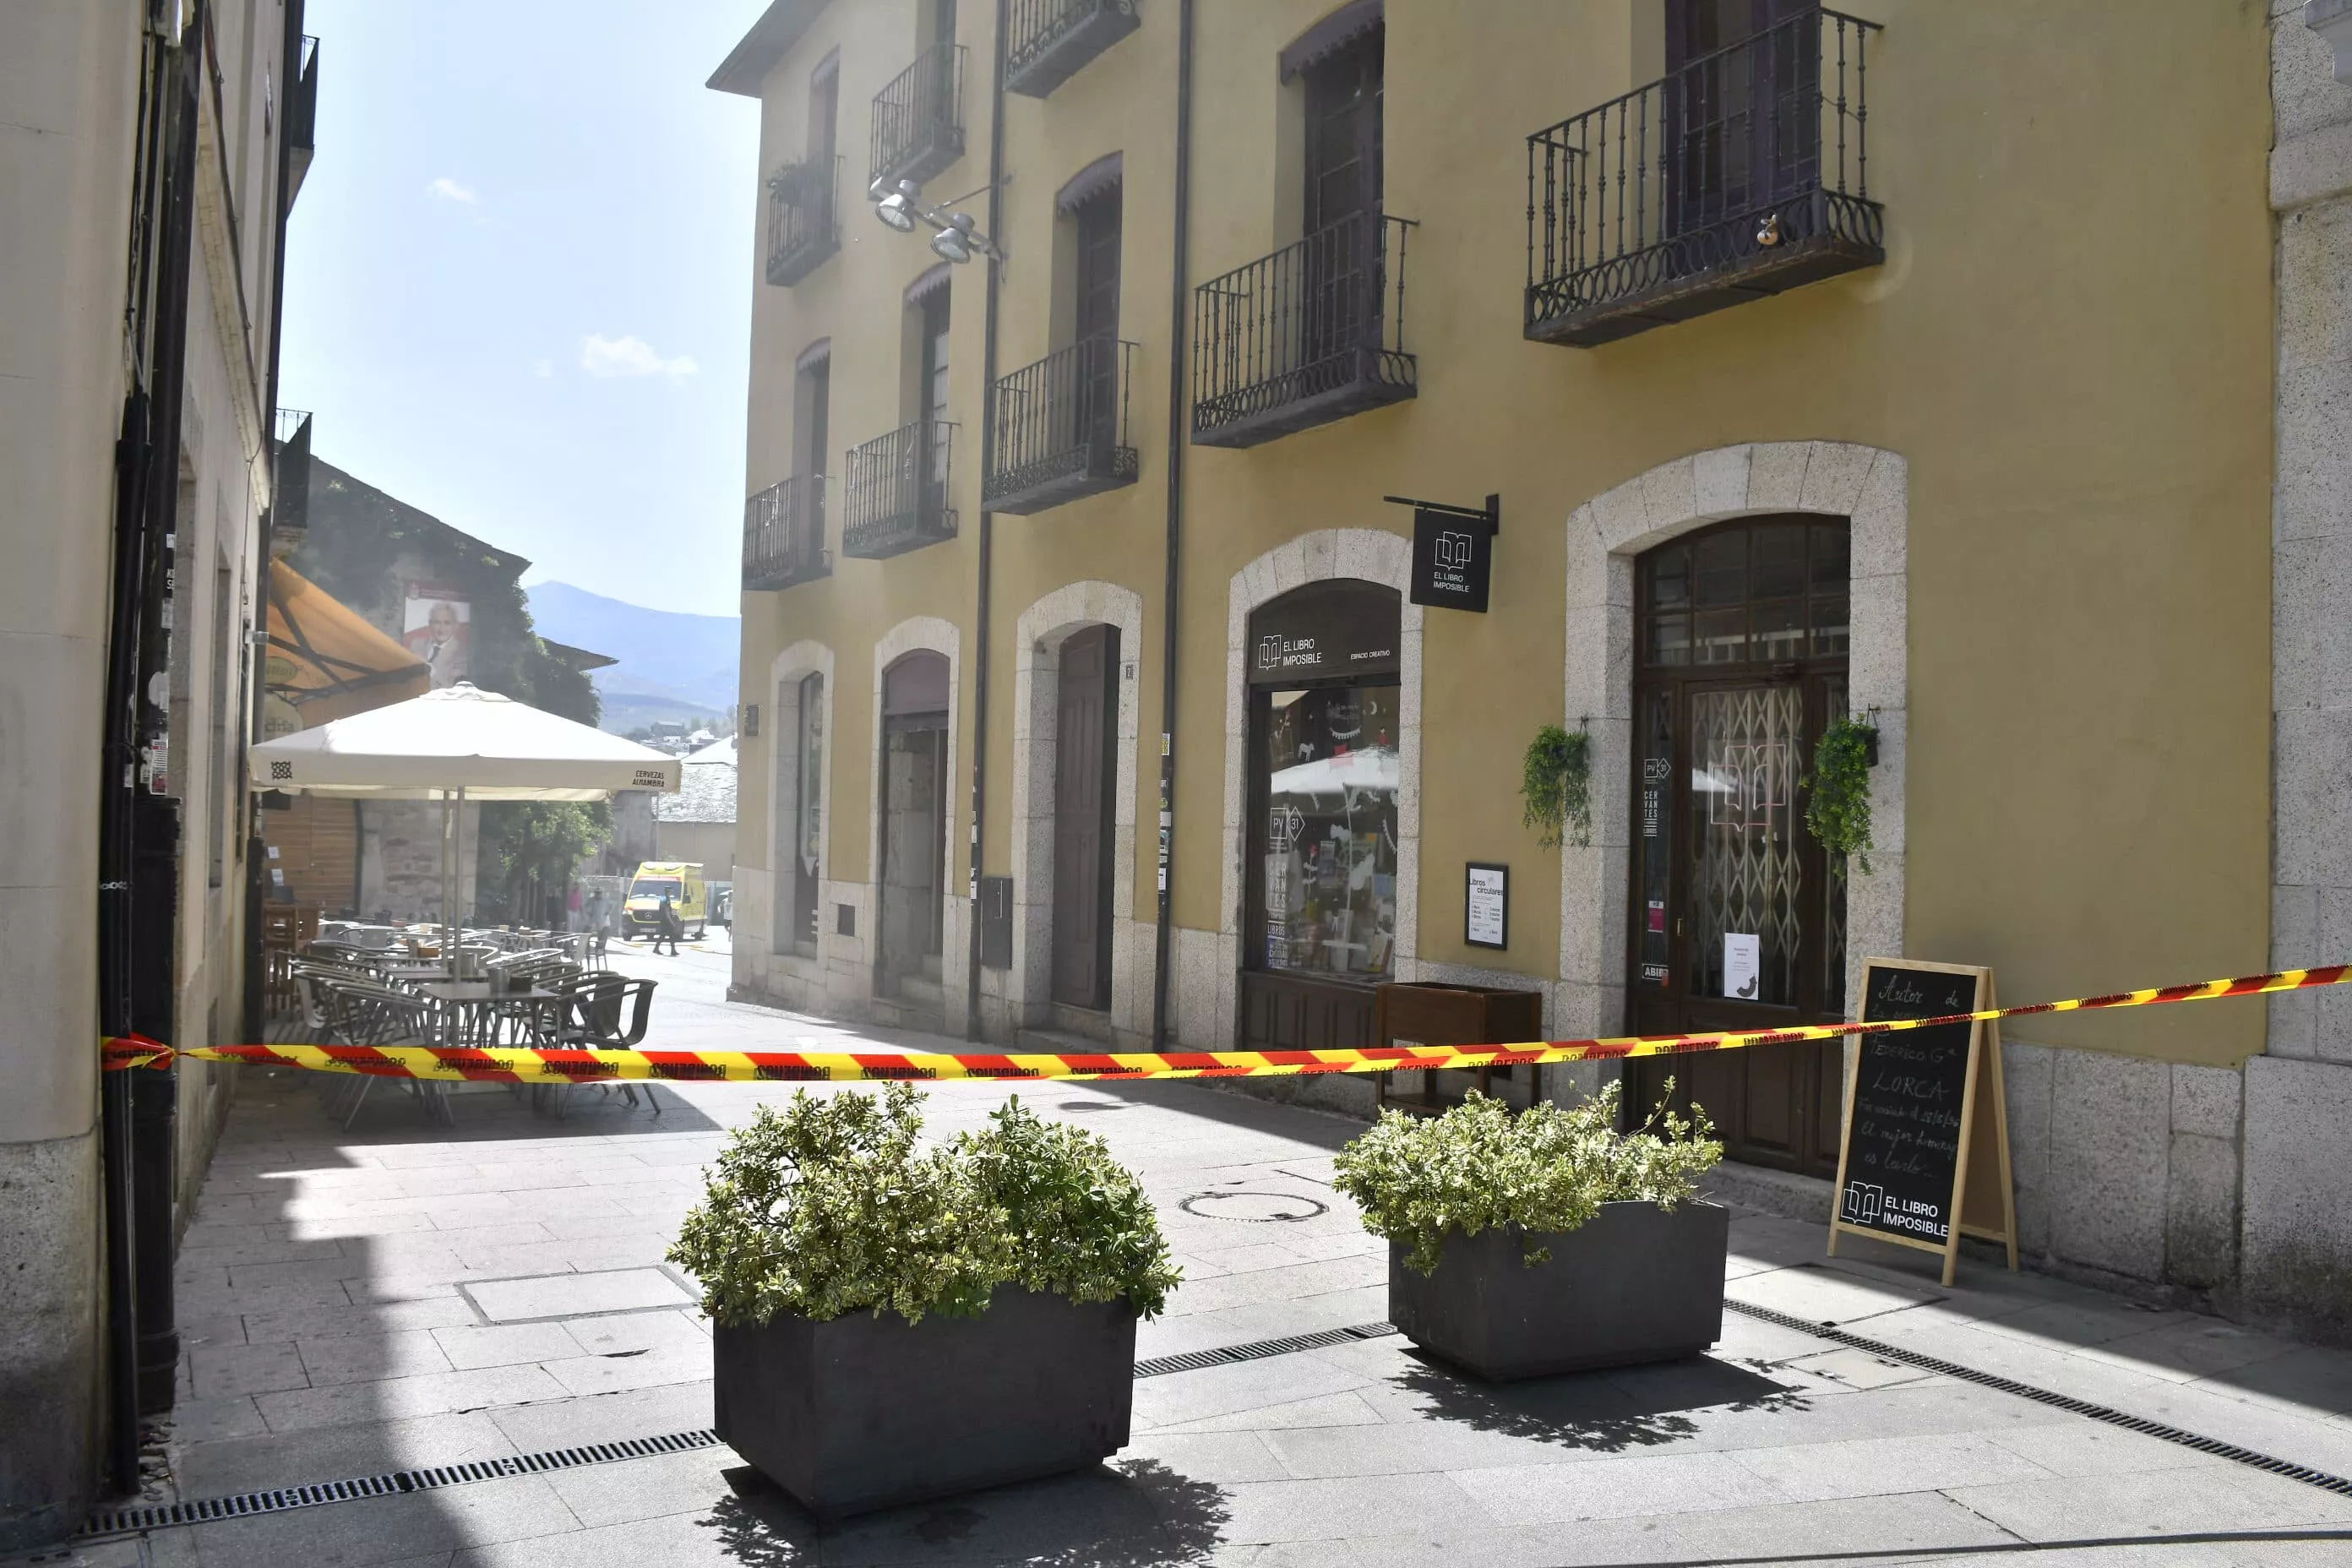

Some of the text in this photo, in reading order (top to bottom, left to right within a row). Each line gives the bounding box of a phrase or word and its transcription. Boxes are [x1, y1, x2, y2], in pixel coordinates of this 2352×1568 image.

[1434, 571, 1463, 583] EL LIBRO
[1433, 581, 1470, 592] IMPOSIBLE
[1283, 638, 1315, 652] EL LIBRO
[1282, 652, 1322, 667] IMPOSIBLE
[1369, 650, 1391, 658] CREATIVO
[635, 770, 664, 779] CERVEZAS
[632, 778, 665, 787] ALHAMBRA
[1644, 791, 1658, 800] CER
[1644, 800, 1658, 809] VAN
[1644, 809, 1658, 818] TES
[1291, 818, 1299, 830] 31
[1267, 924, 1285, 937] LIBROS
[1873, 1065, 1950, 1102] LORCA
[1885, 1195, 1939, 1217] EL LIBRO
[1882, 1211, 1950, 1238] IMPOSIBLE
